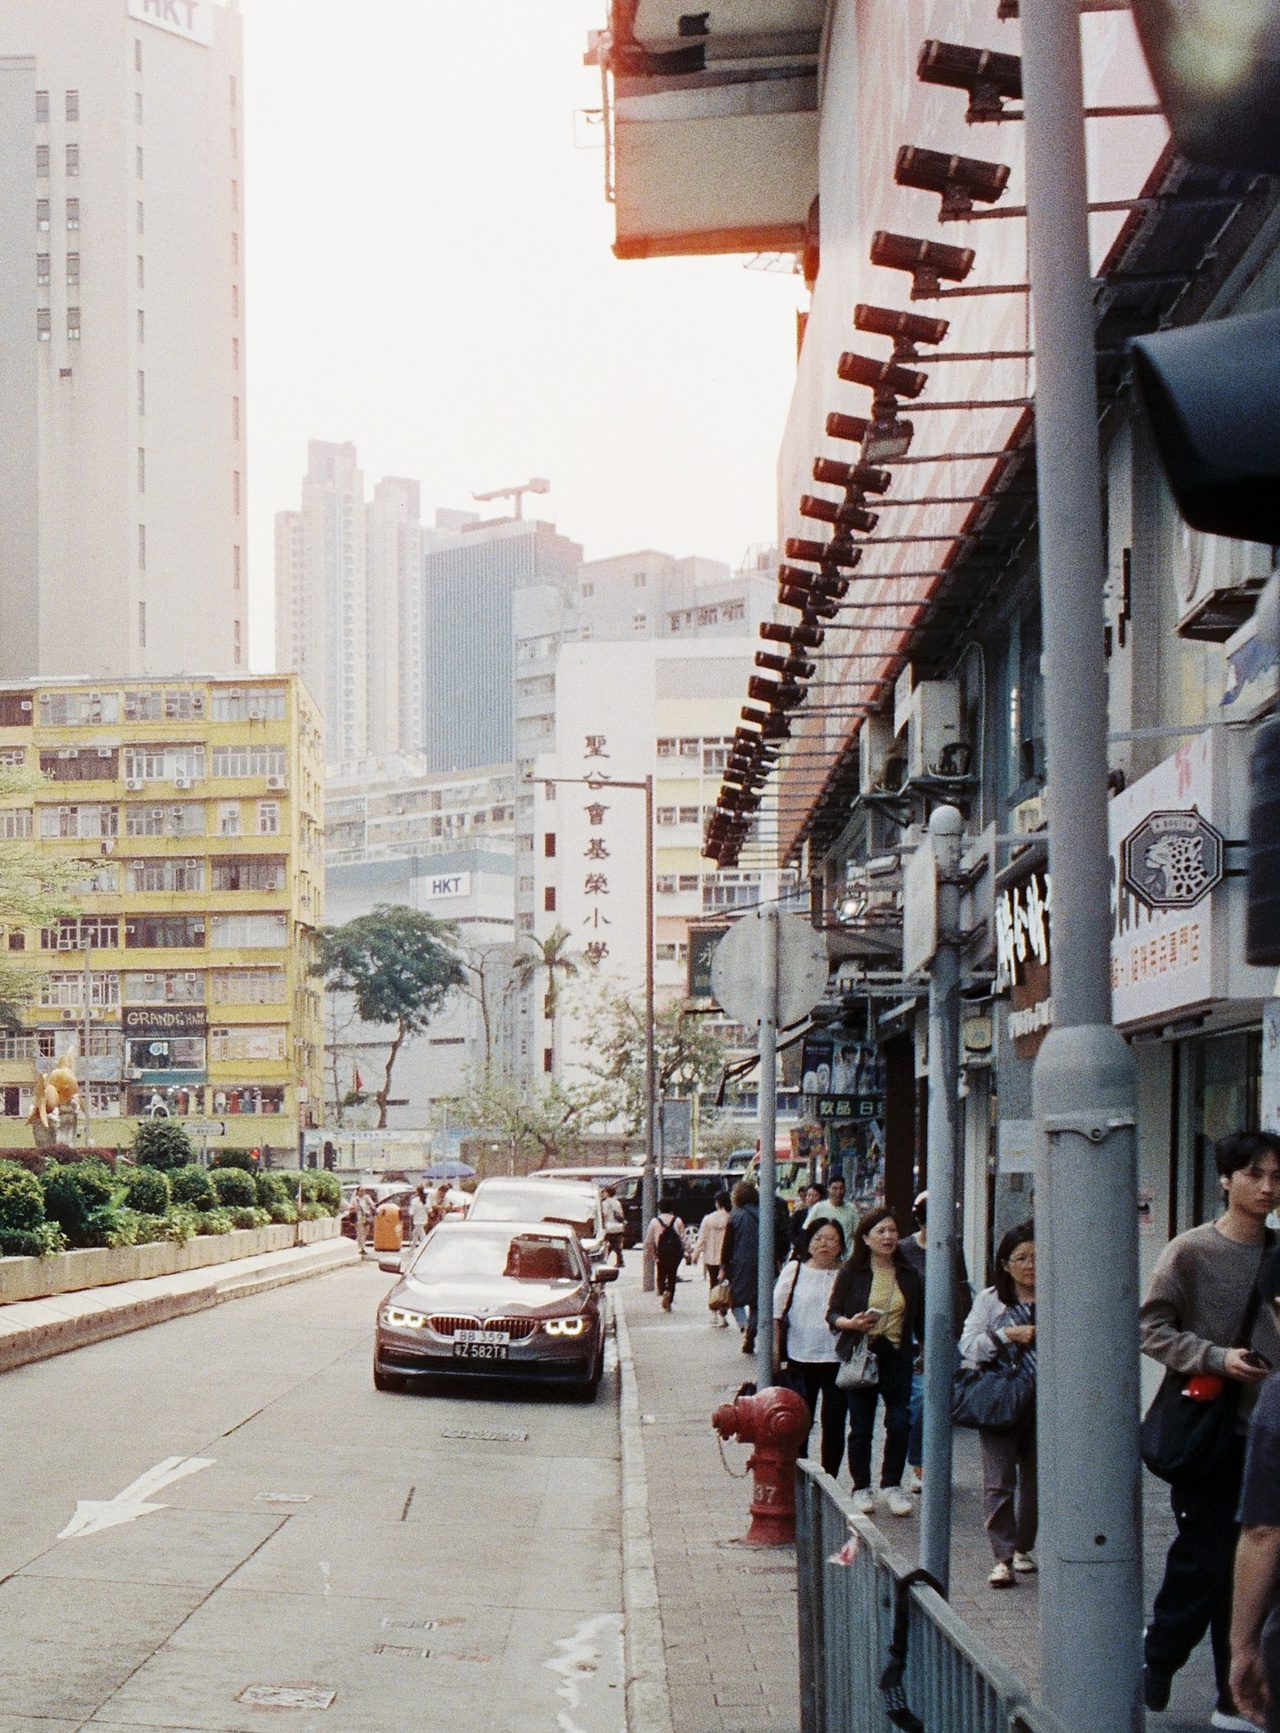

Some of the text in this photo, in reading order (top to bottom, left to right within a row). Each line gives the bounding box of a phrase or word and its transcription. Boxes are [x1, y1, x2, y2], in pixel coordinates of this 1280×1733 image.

[583, 734, 611, 965] 聖公會基榮小學
[432, 877, 461, 894] HKT
[127, 1011, 175, 1026] GRAND
